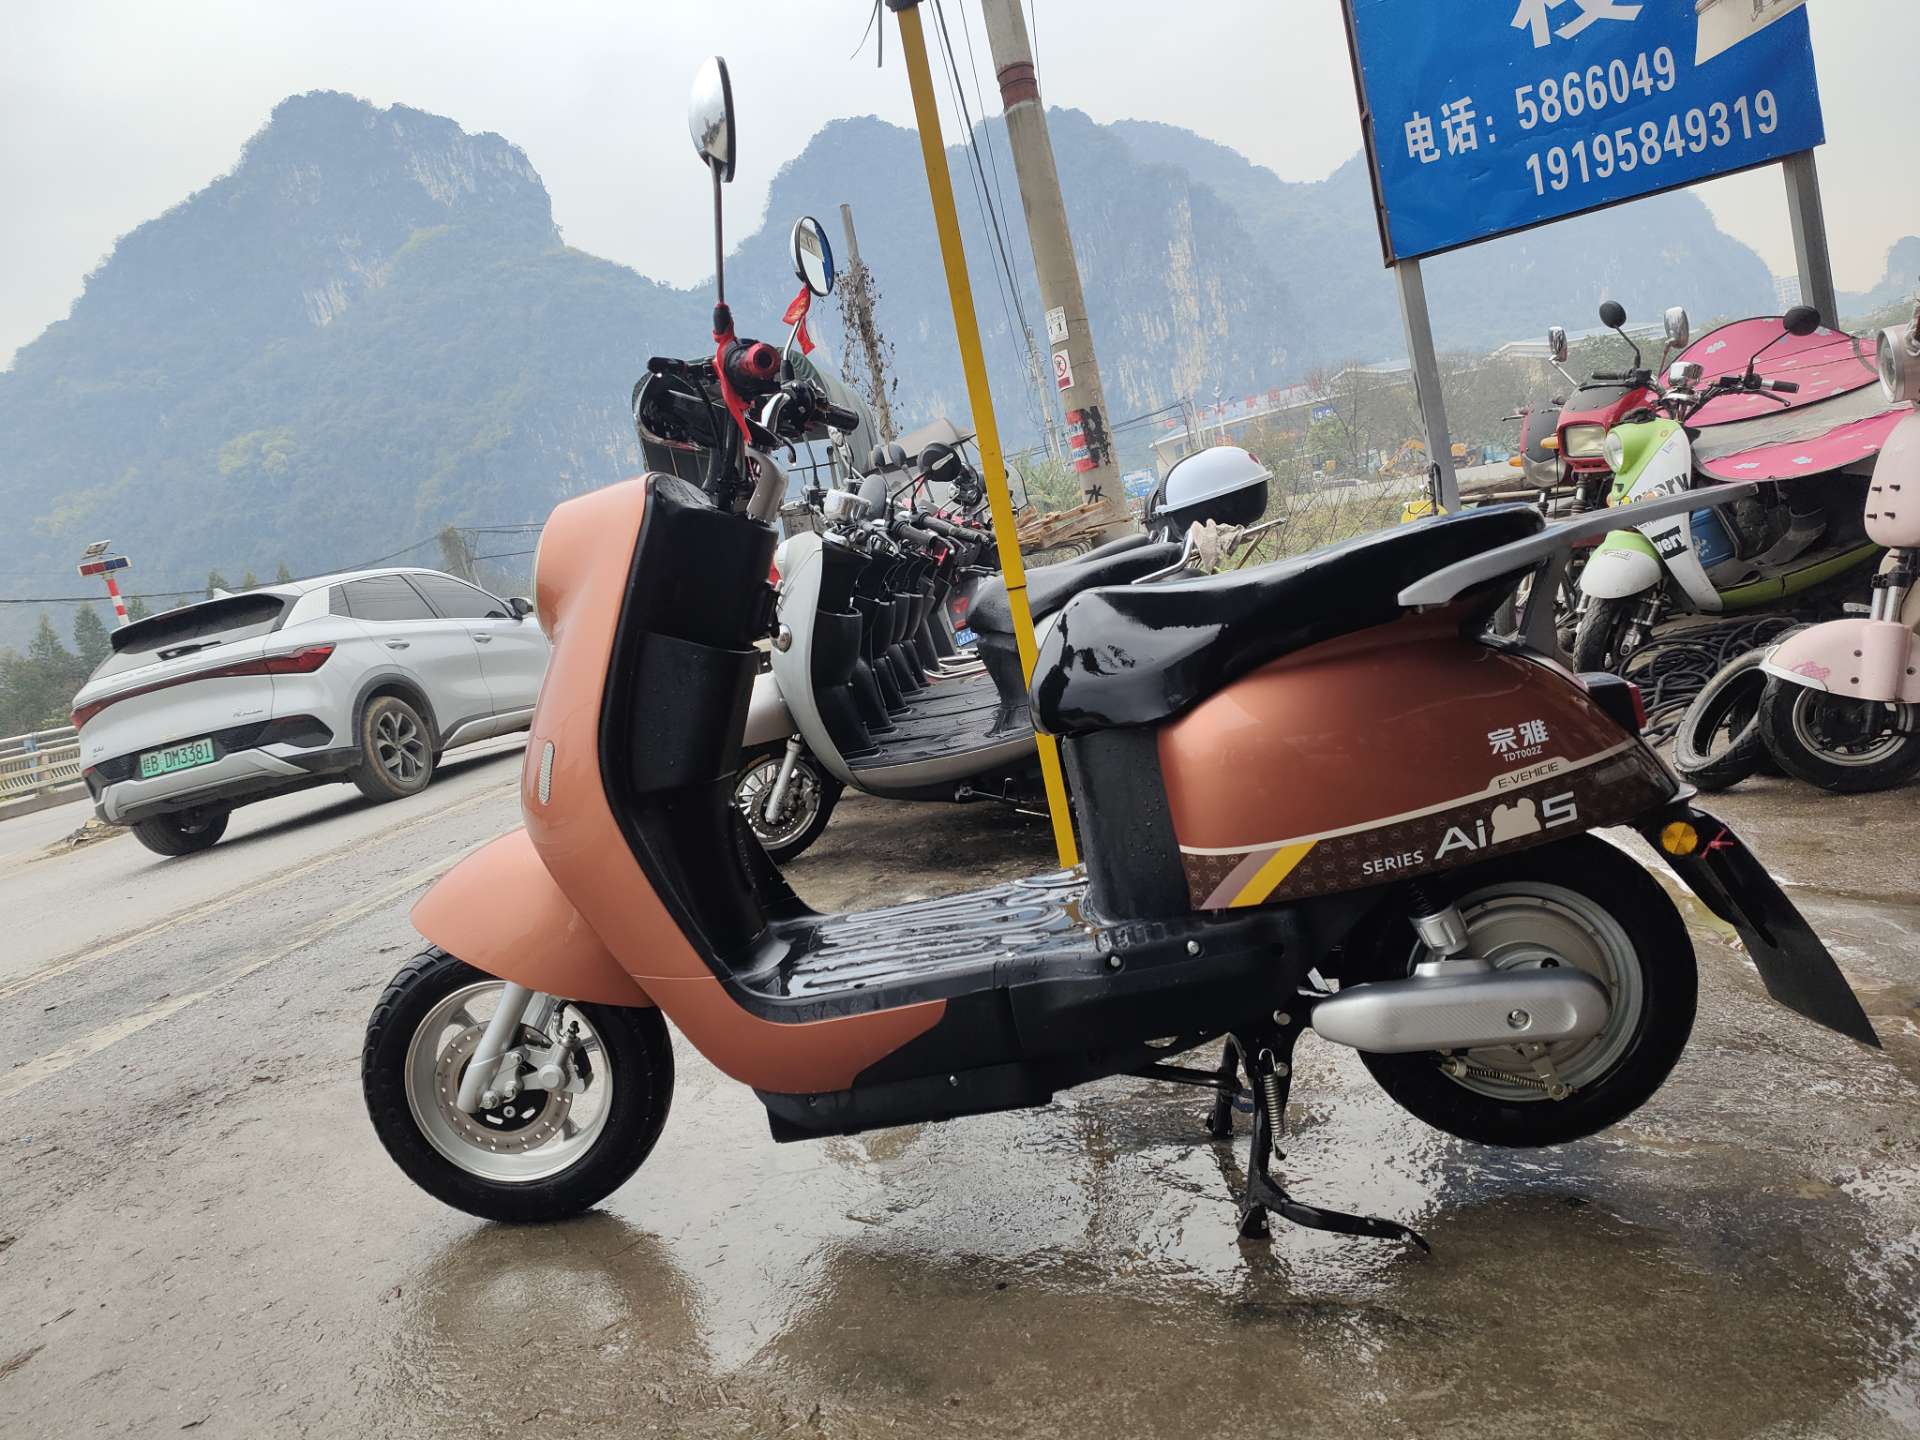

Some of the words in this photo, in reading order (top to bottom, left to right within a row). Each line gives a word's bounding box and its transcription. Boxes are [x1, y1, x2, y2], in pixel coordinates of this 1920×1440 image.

[1515, 46, 1676, 130] 5866049
[1526, 89, 1778, 196] 19195849319
[164, 742, 210, 768] DM3381
[1487, 719, 1550, 755] 宗雅
[1362, 850, 1425, 876] SERIES
